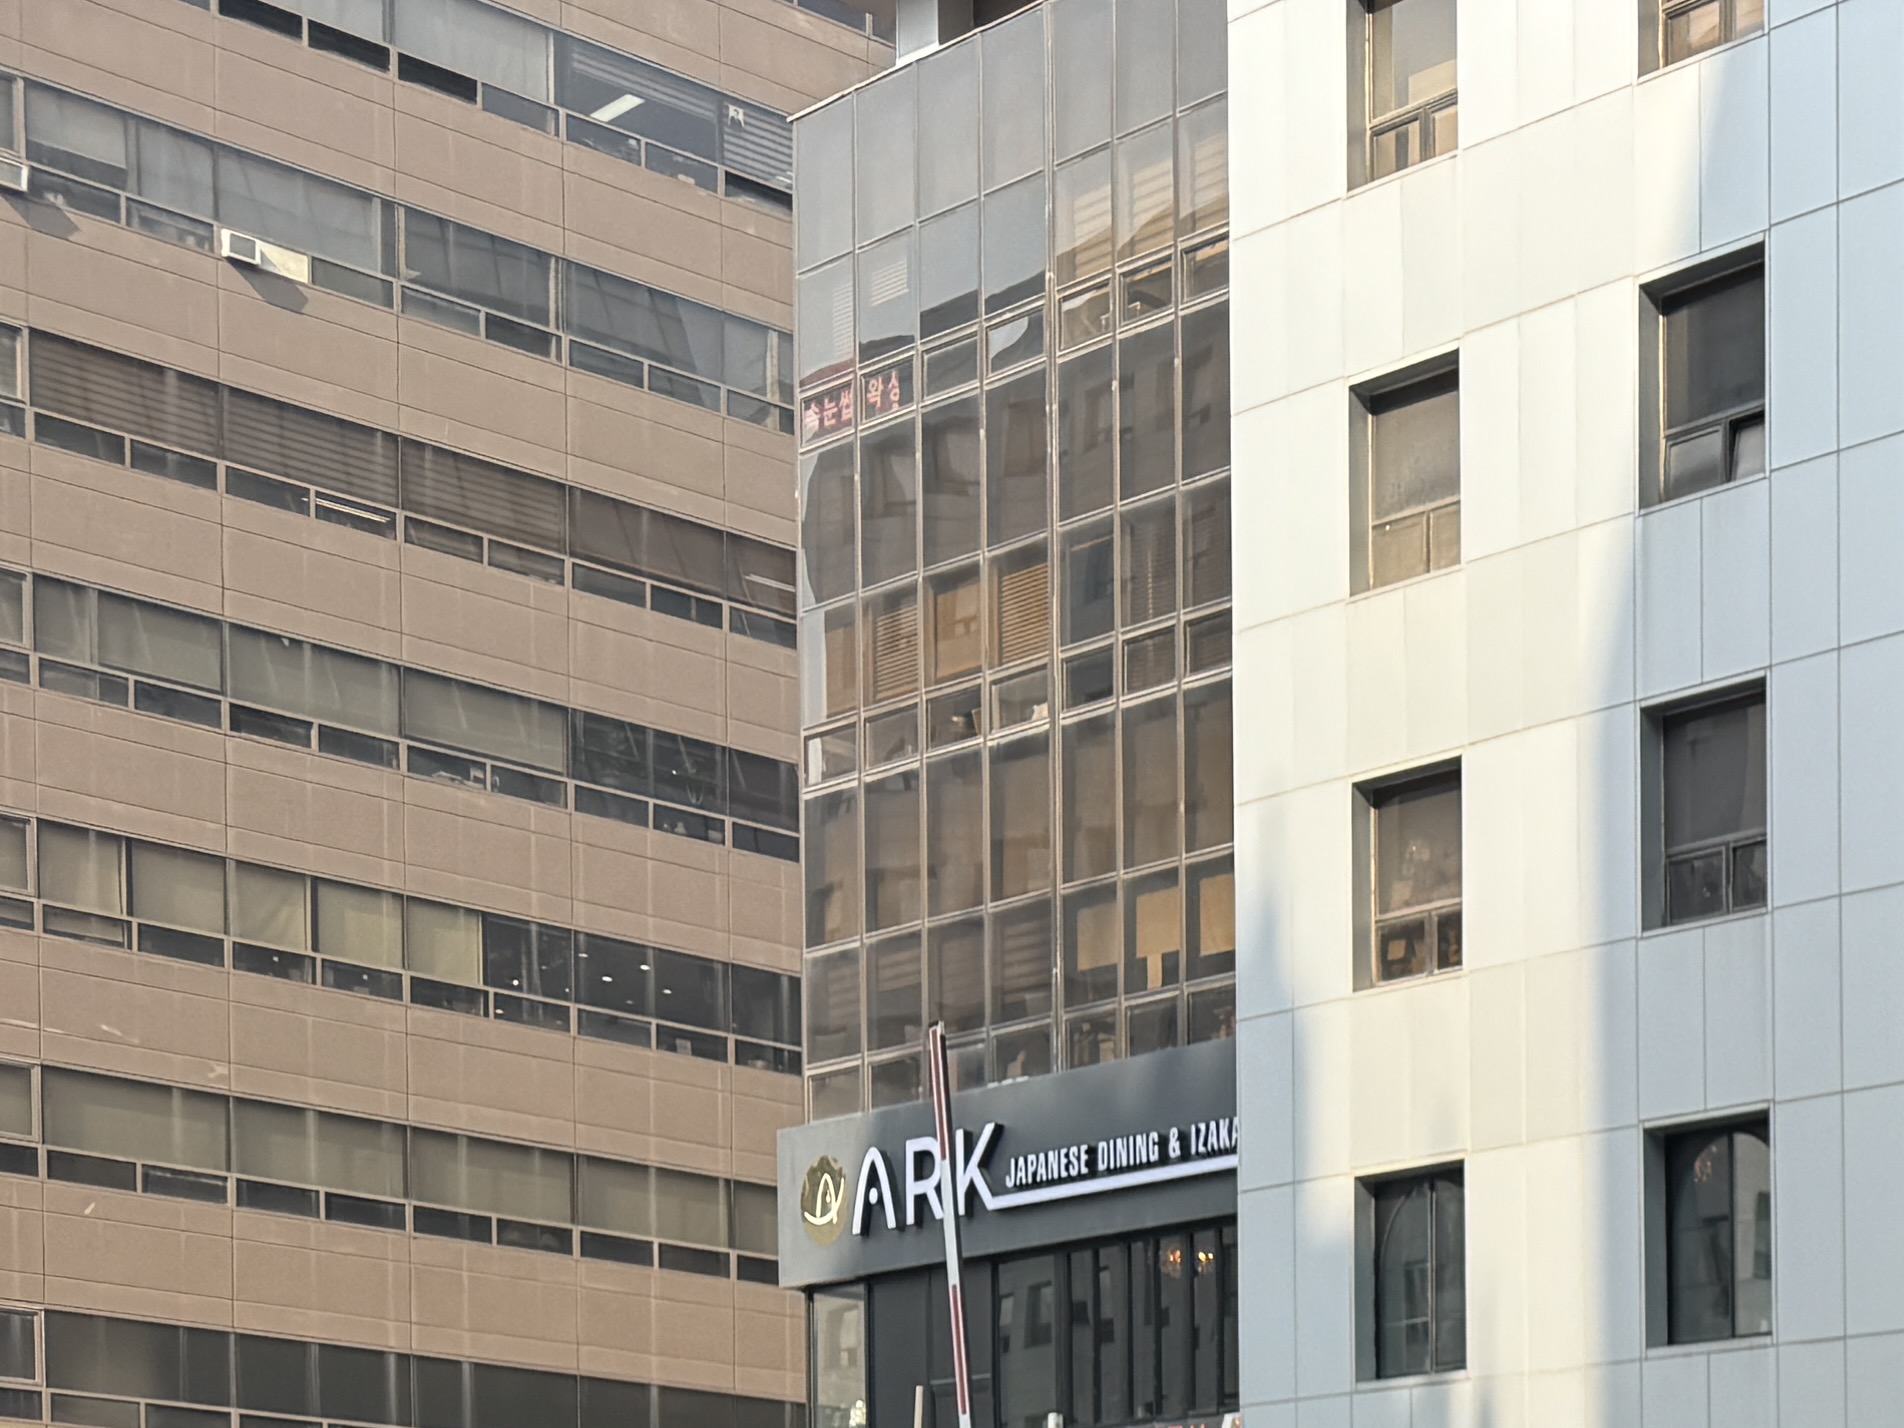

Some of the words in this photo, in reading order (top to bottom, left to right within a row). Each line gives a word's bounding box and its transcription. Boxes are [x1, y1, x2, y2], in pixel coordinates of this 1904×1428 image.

[852, 1122, 999, 1235] ARK
[1005, 1144, 1090, 1188] JAPANESE
[1098, 1131, 1160, 1170] DINING
[1168, 1126, 1182, 1158] &
